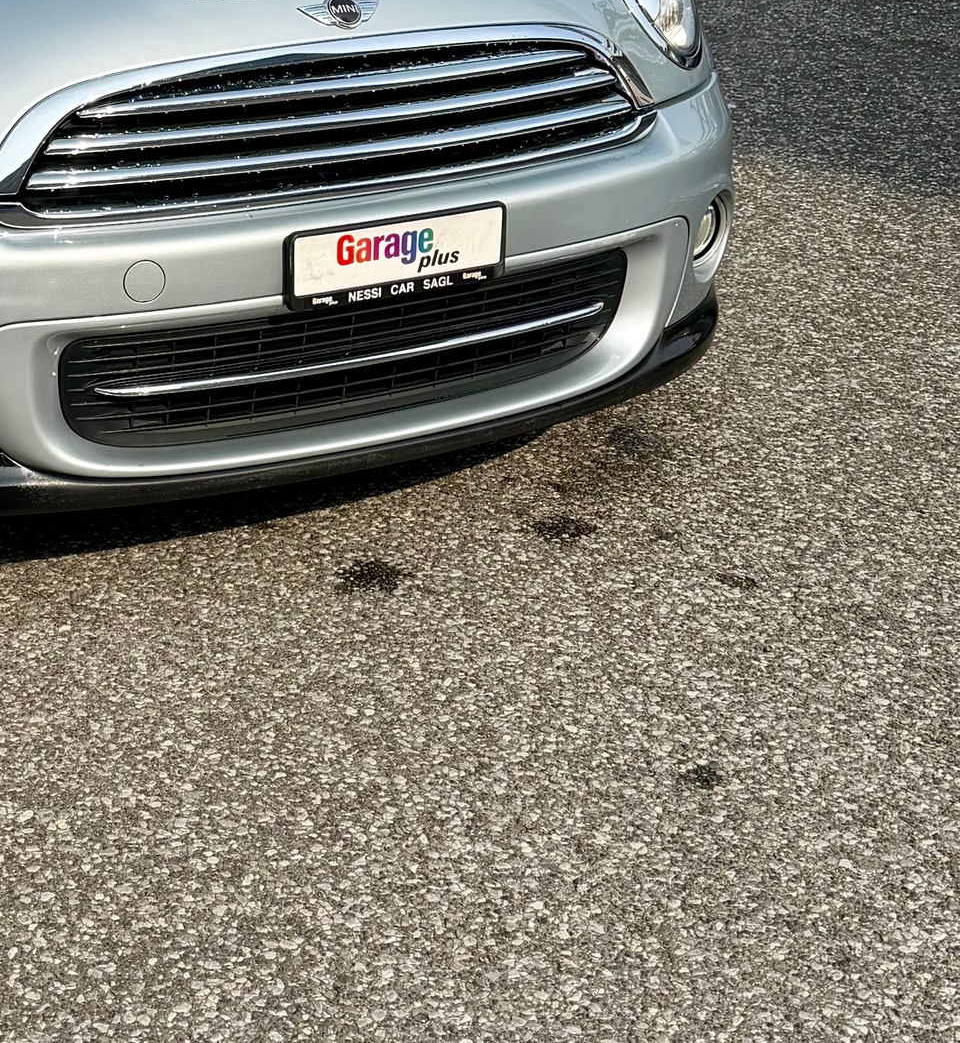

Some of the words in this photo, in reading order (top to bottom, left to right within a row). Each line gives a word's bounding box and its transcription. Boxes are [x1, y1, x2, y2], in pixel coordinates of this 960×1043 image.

[330, 4, 359, 14] MINI
[336, 227, 434, 266] Garage
[417, 250, 460, 273] plus
[348, 287, 382, 303] NESSI
[390, 281, 415, 296] CAR
[423, 275, 453, 290] SAGL
